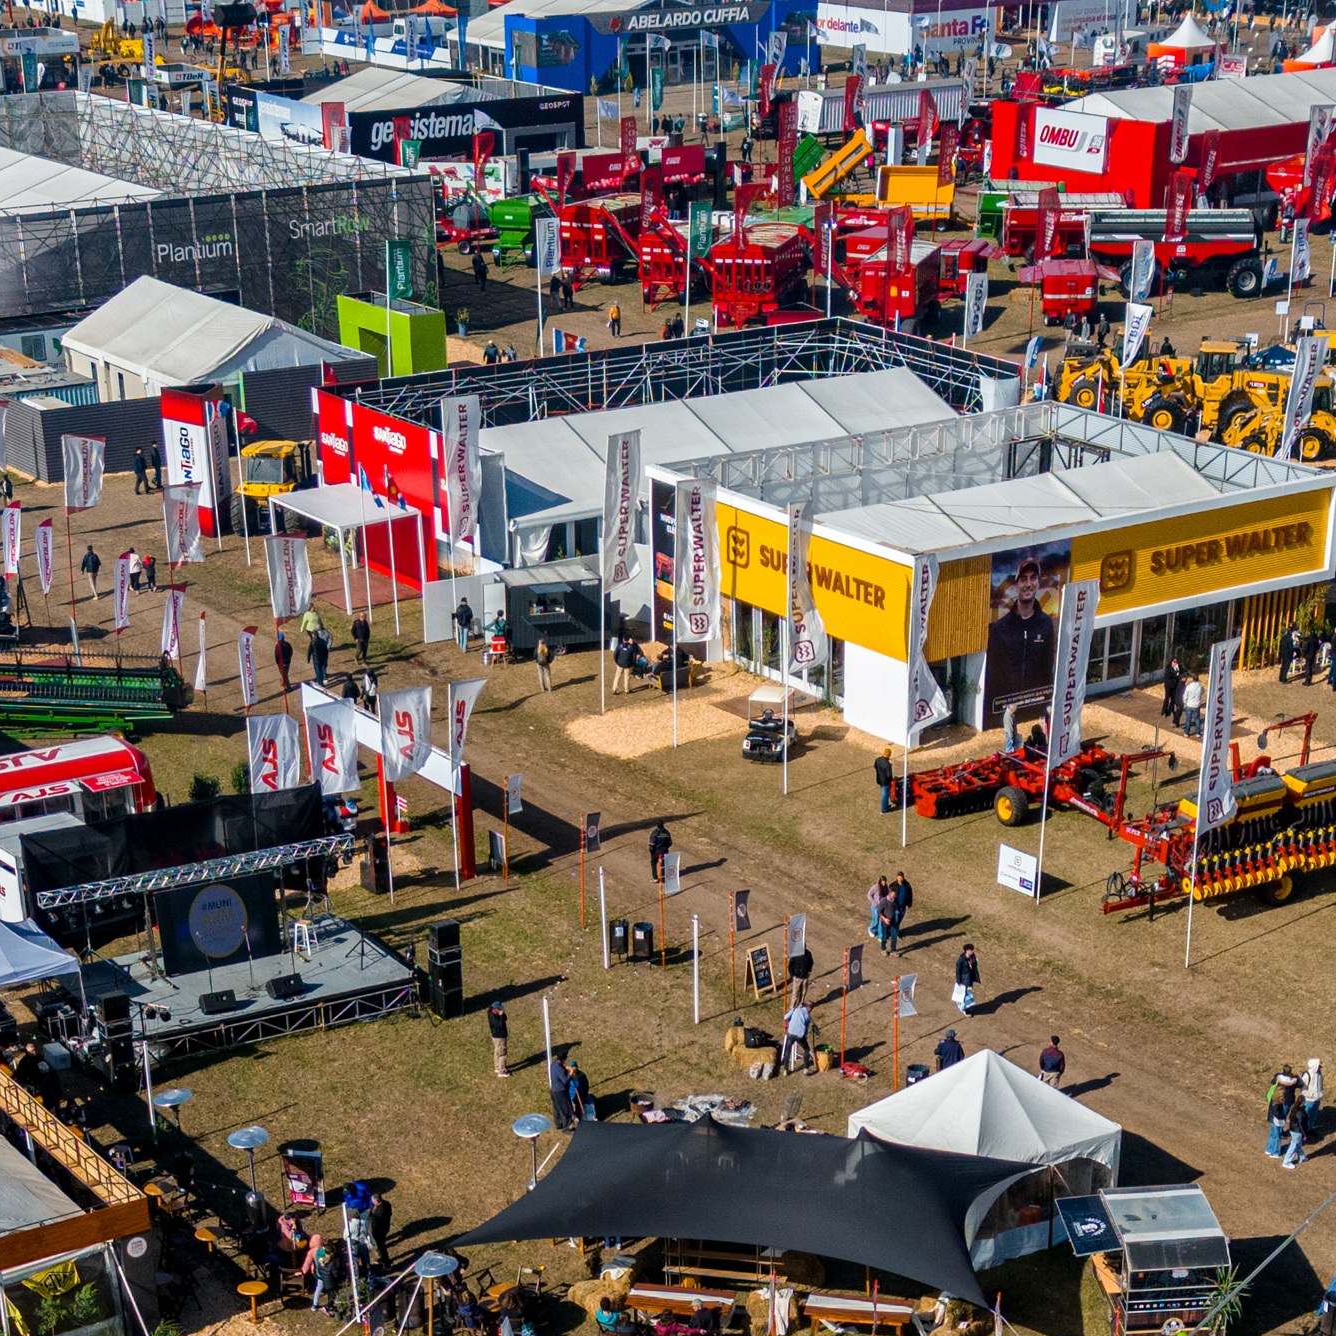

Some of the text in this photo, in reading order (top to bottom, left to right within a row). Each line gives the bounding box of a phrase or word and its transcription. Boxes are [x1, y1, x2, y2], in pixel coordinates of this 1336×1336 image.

[628, 7, 750, 32] ABELARDO CUFFIA
[1039, 124, 1079, 148] OMBU
[289, 216, 370, 239] SmartRow
[545, 222, 557, 268] Plantium
[698, 210, 709, 252] Plantium
[157, 239, 233, 263] Plantium
[395, 247, 405, 290] Plantium
[1150, 521, 1314, 573] SUPER WALTER
[815, 565, 886, 612] WALTER
[392, 709, 416, 761] AJS
[454, 698, 467, 749] AJS
[261, 737, 280, 789] AJS
[315, 722, 339, 775] AJS
[12, 783, 71, 803] AJS
[202, 899, 232, 910] #MUNI
